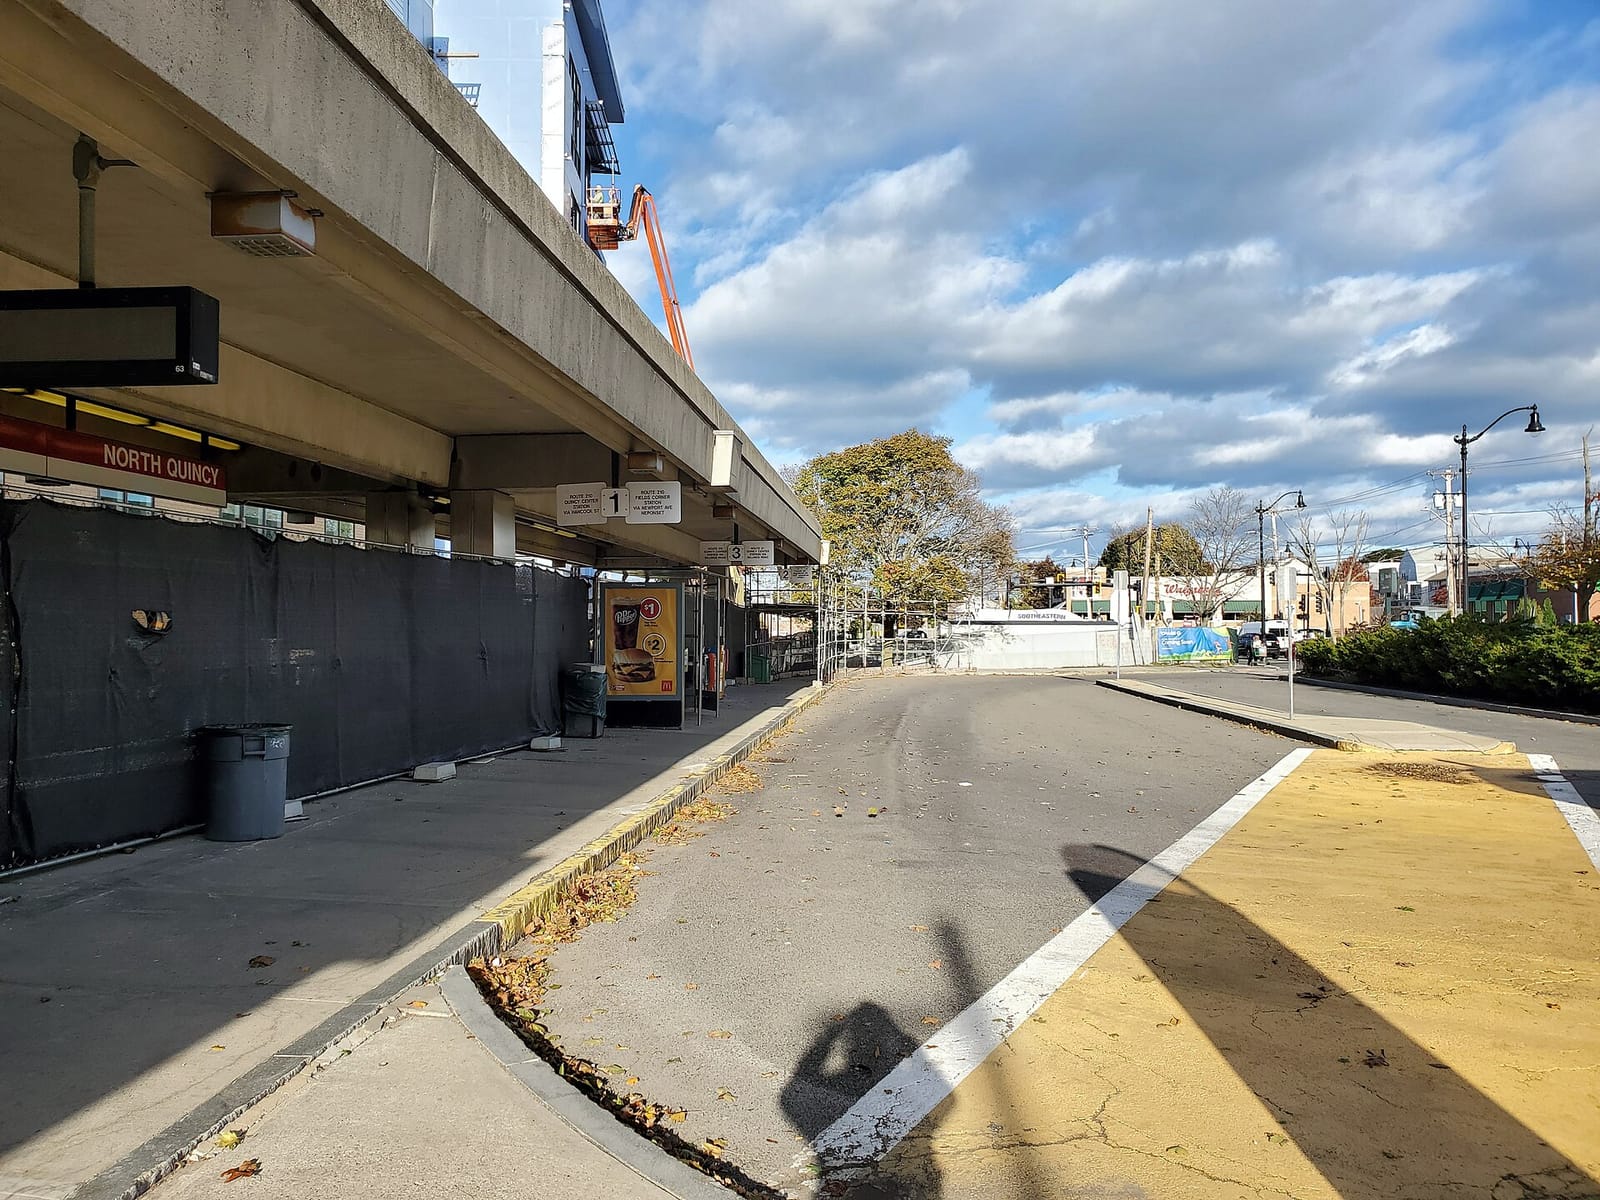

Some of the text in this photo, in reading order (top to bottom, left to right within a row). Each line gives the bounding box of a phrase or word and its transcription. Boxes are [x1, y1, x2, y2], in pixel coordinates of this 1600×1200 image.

[175, 365, 185, 373] 63
[103, 443, 219, 486] NORTH QUINCY
[608, 492, 619, 514] 1
[731, 546, 741, 560] 3
[782, 570, 789, 579] 2
[1163, 584, 1222, 597] Walgrees
[644, 603, 655, 615] $1
